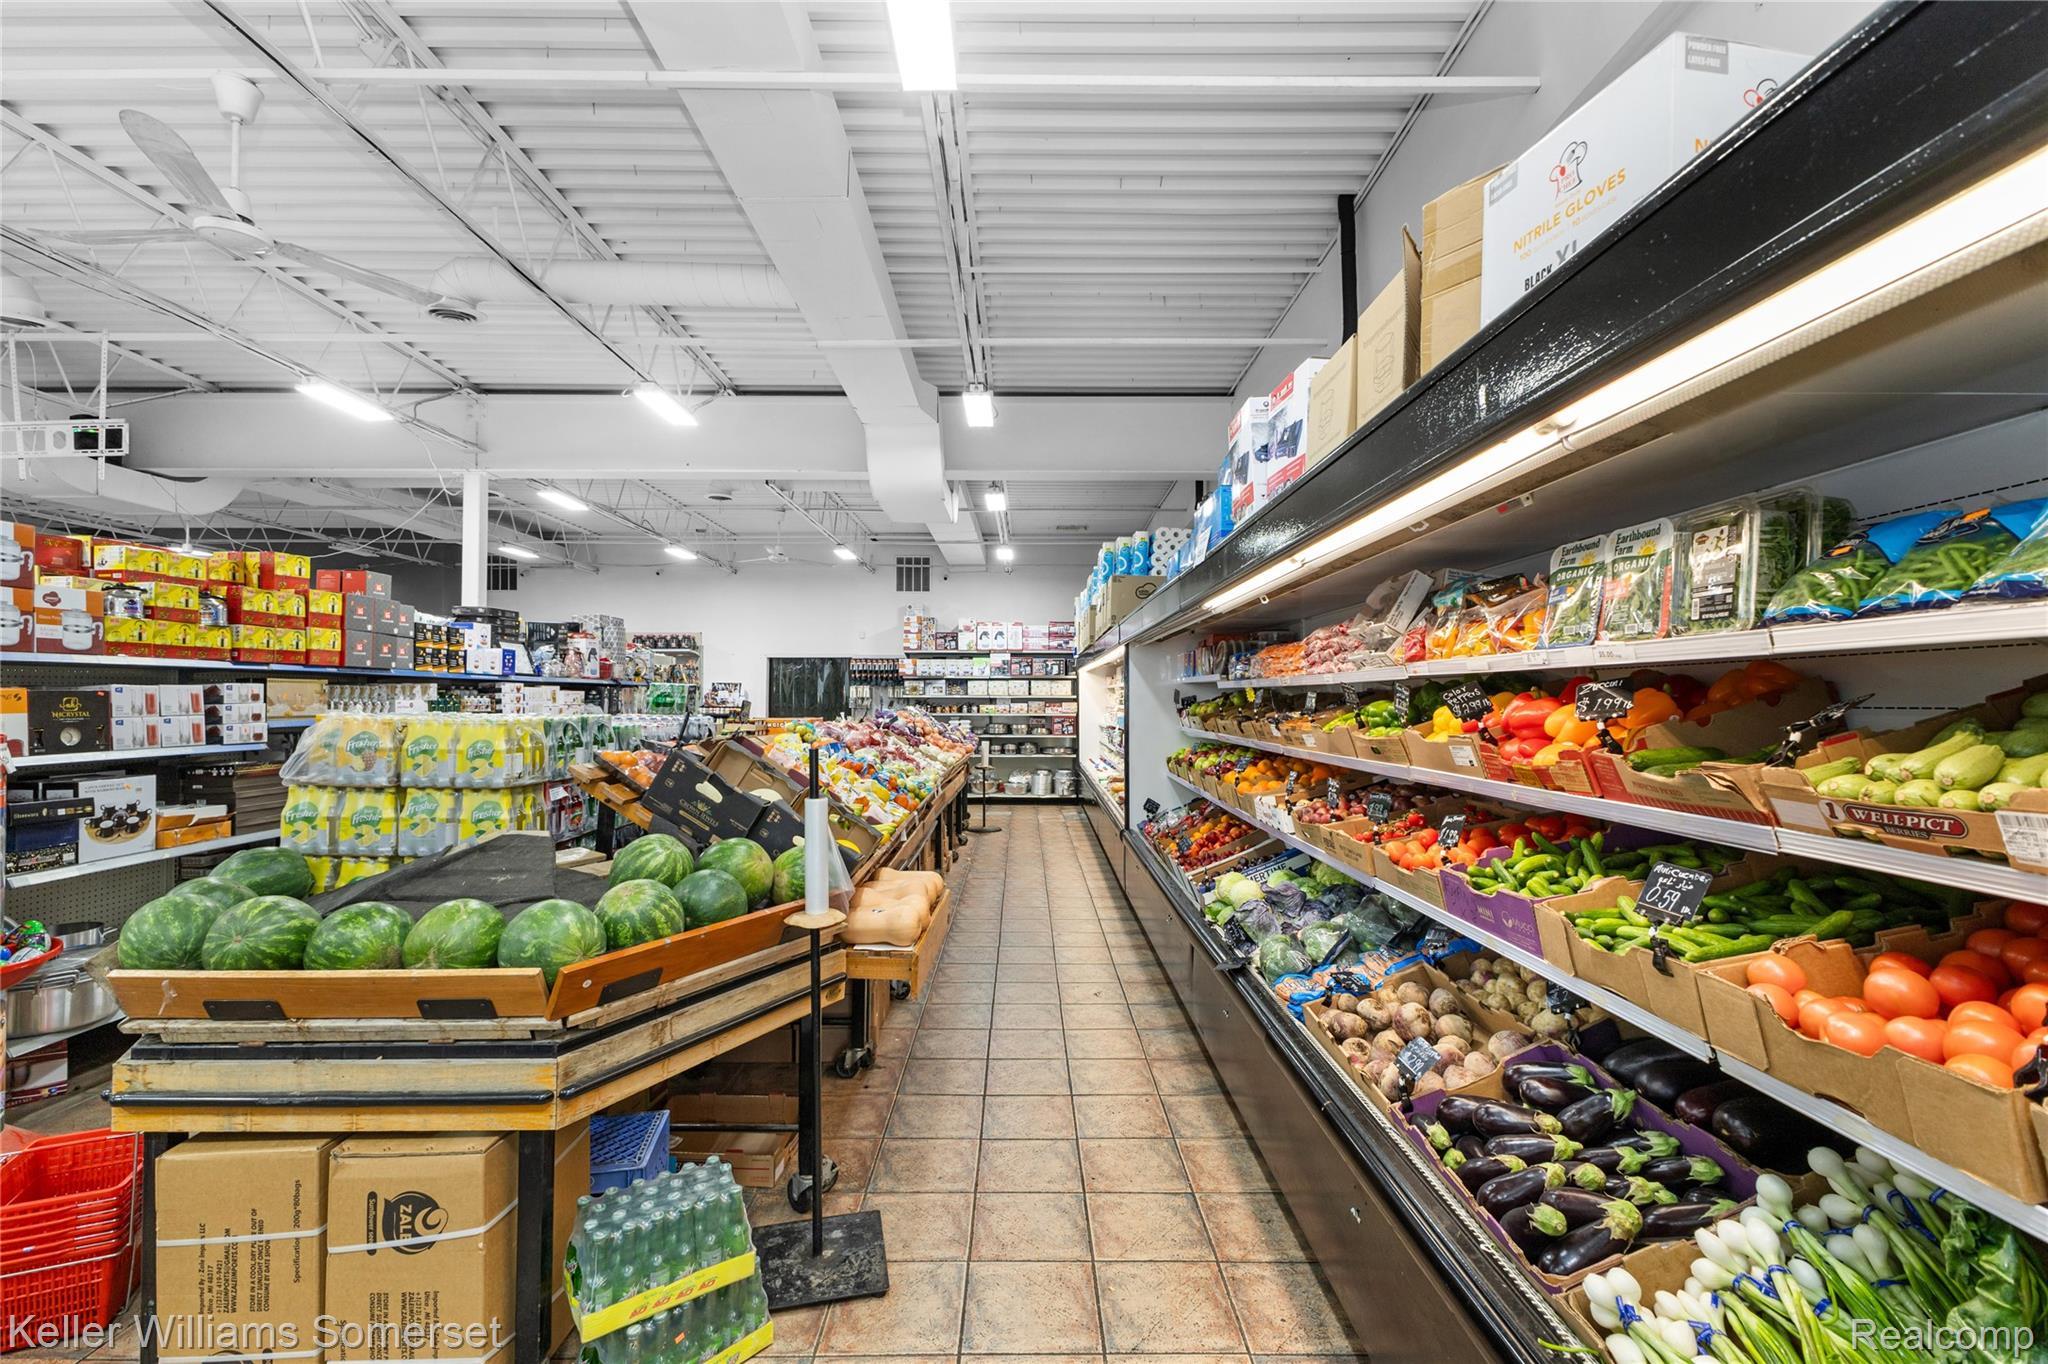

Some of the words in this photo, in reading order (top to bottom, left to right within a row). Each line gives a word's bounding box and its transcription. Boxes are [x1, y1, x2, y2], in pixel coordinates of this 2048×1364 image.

[1513, 212, 1561, 253] NITRILE
[1565, 168, 1626, 218] GLOVES
[1524, 264, 1553, 291] BLACK
[1615, 523, 1661, 545] Earthbound
[1561, 538, 1600, 557] Earthbound
[1614, 545, 1634, 556] Farm
[1558, 556, 1576, 567] Farm
[1613, 556, 1656, 573] ORGANIC
[1556, 566, 1596, 582] ORGANIC
[285, 807, 318, 823] Fresher
[406, 801, 438, 816] Fresher
[1826, 802, 1838, 820] 1
[1884, 825, 1929, 839] BERRIES
[1645, 886, 1681, 911] 0.59
[400, 1204, 412, 1241] ZALE
[198, 1235, 206, 1258] Impos
[198, 1287, 206, 1315] Imported
